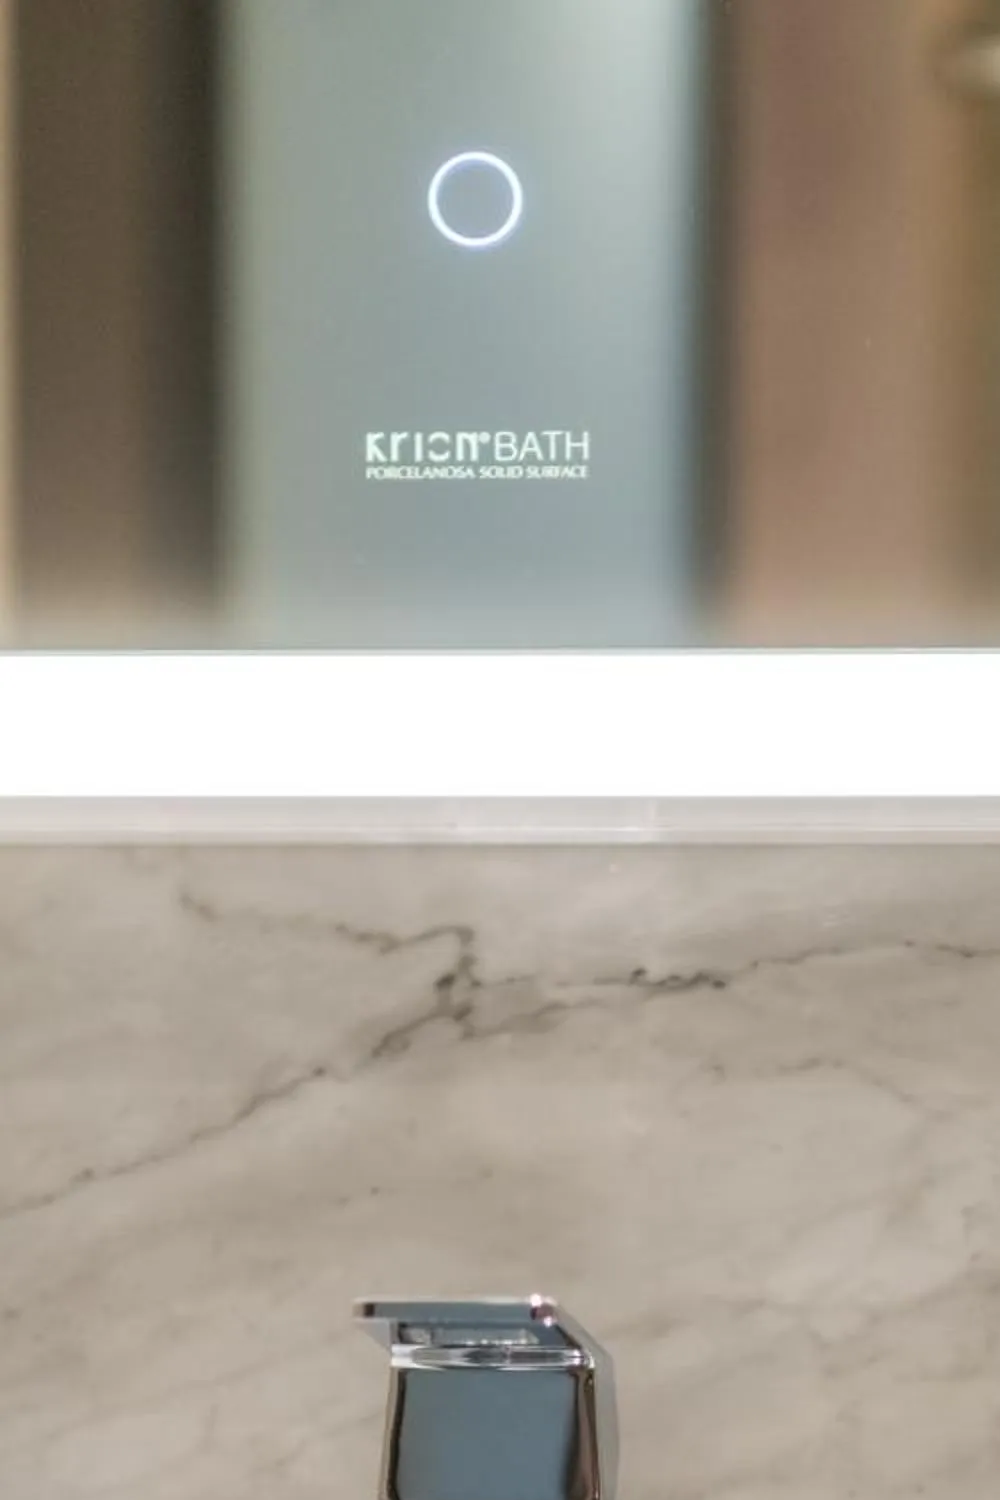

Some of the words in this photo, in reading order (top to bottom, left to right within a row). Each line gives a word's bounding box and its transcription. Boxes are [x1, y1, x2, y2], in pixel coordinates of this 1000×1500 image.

[494, 431, 590, 461] BATH
[366, 465, 474, 479] PORCELANOSA
[480, 465, 523, 479] SOLID
[526, 465, 588, 479] SURFACE
